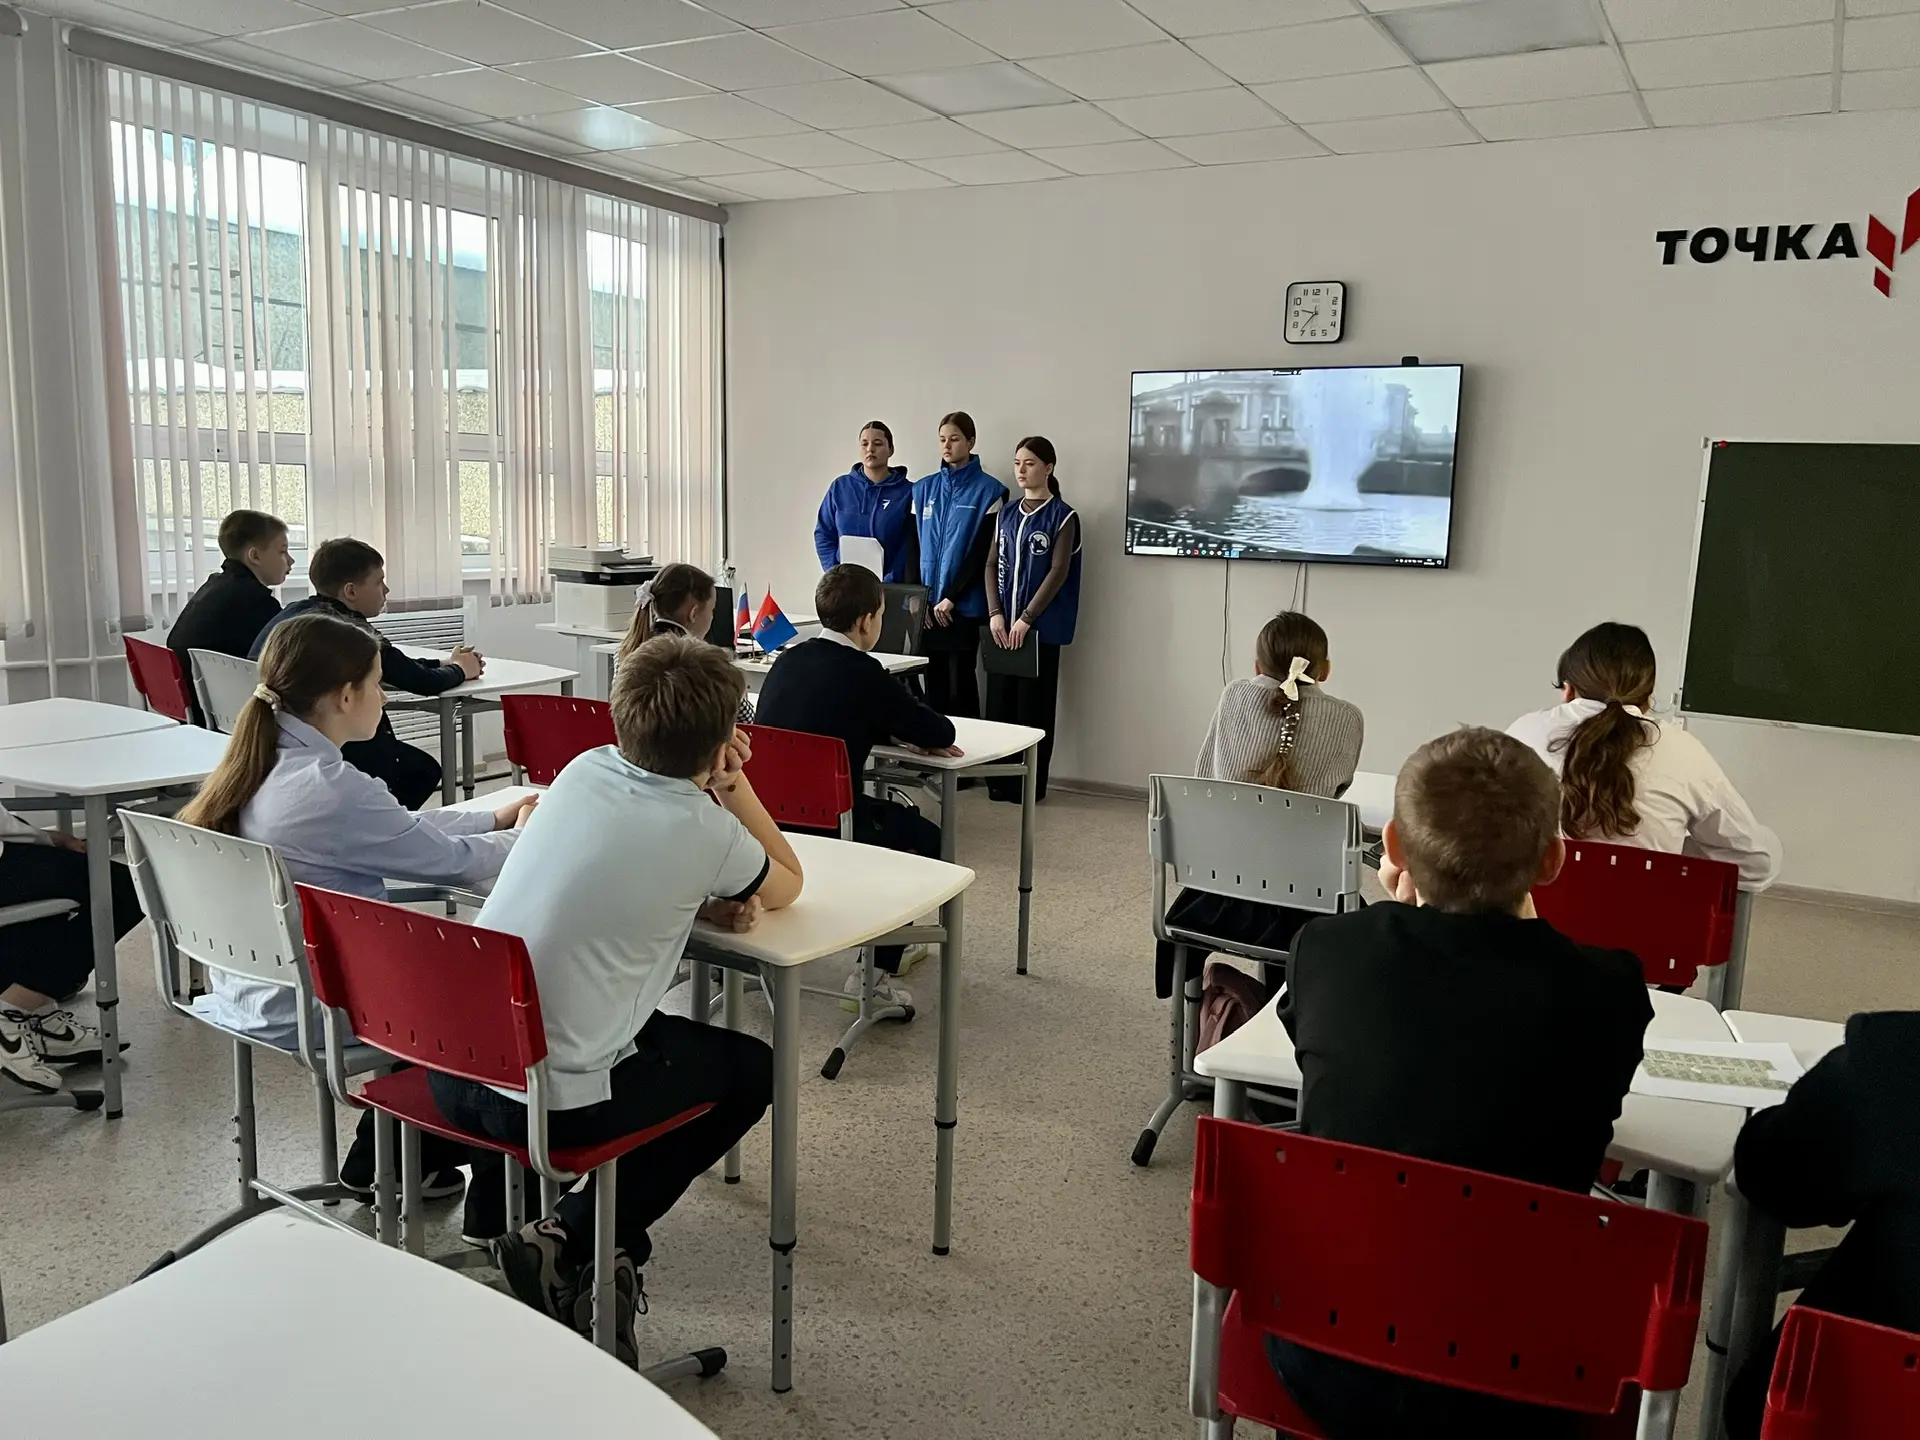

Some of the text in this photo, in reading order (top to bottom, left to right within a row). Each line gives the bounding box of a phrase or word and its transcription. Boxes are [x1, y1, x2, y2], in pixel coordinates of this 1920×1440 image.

[1655, 222, 1860, 265] ТОЧКА
[1293, 297, 1302, 306] 10
[1332, 297, 1338, 305] 2
